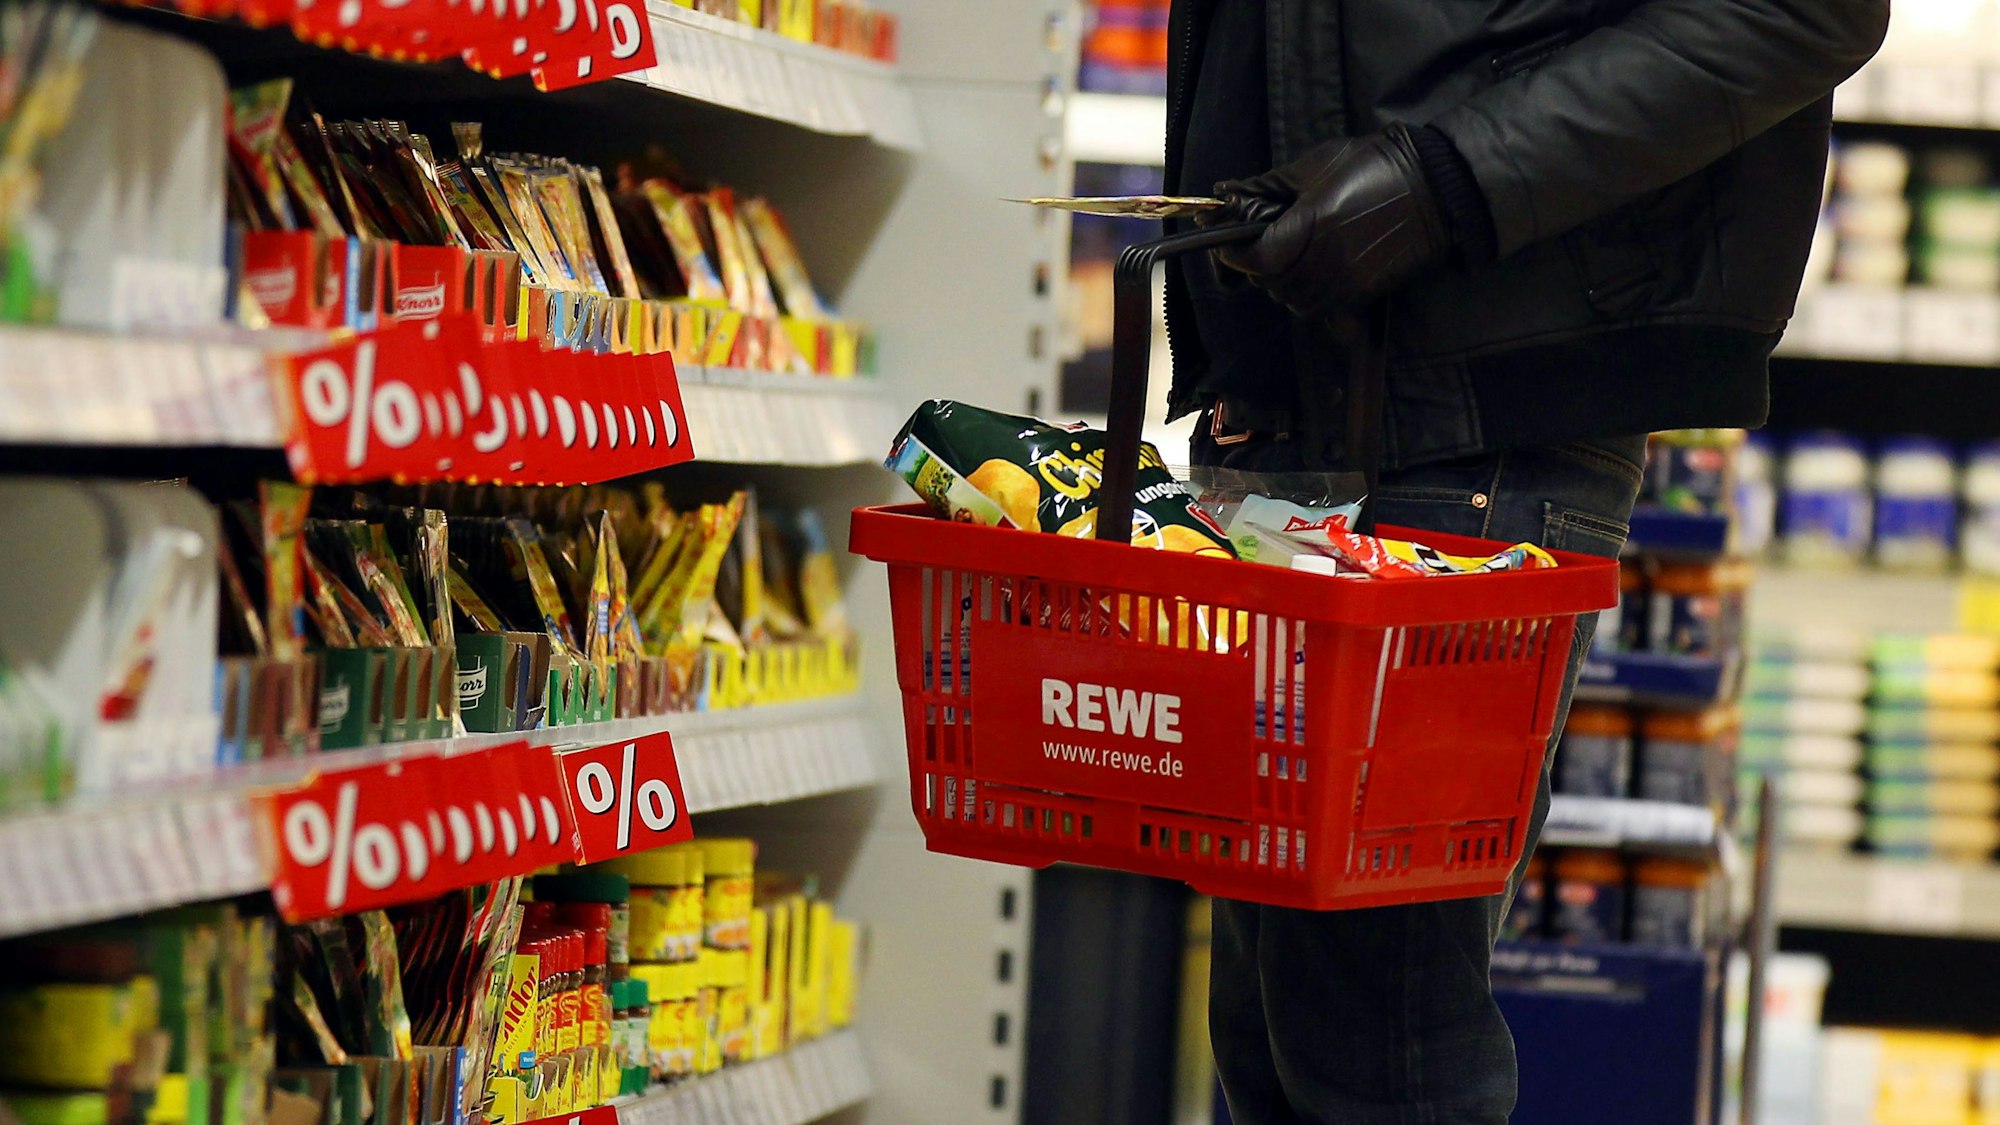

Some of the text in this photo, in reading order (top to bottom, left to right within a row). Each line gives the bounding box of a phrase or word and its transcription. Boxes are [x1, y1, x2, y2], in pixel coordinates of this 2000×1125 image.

[459, 679, 484, 692] orr
[1042, 678, 1183, 744] REWE
[1042, 741, 1184, 778] www.rewe.de
